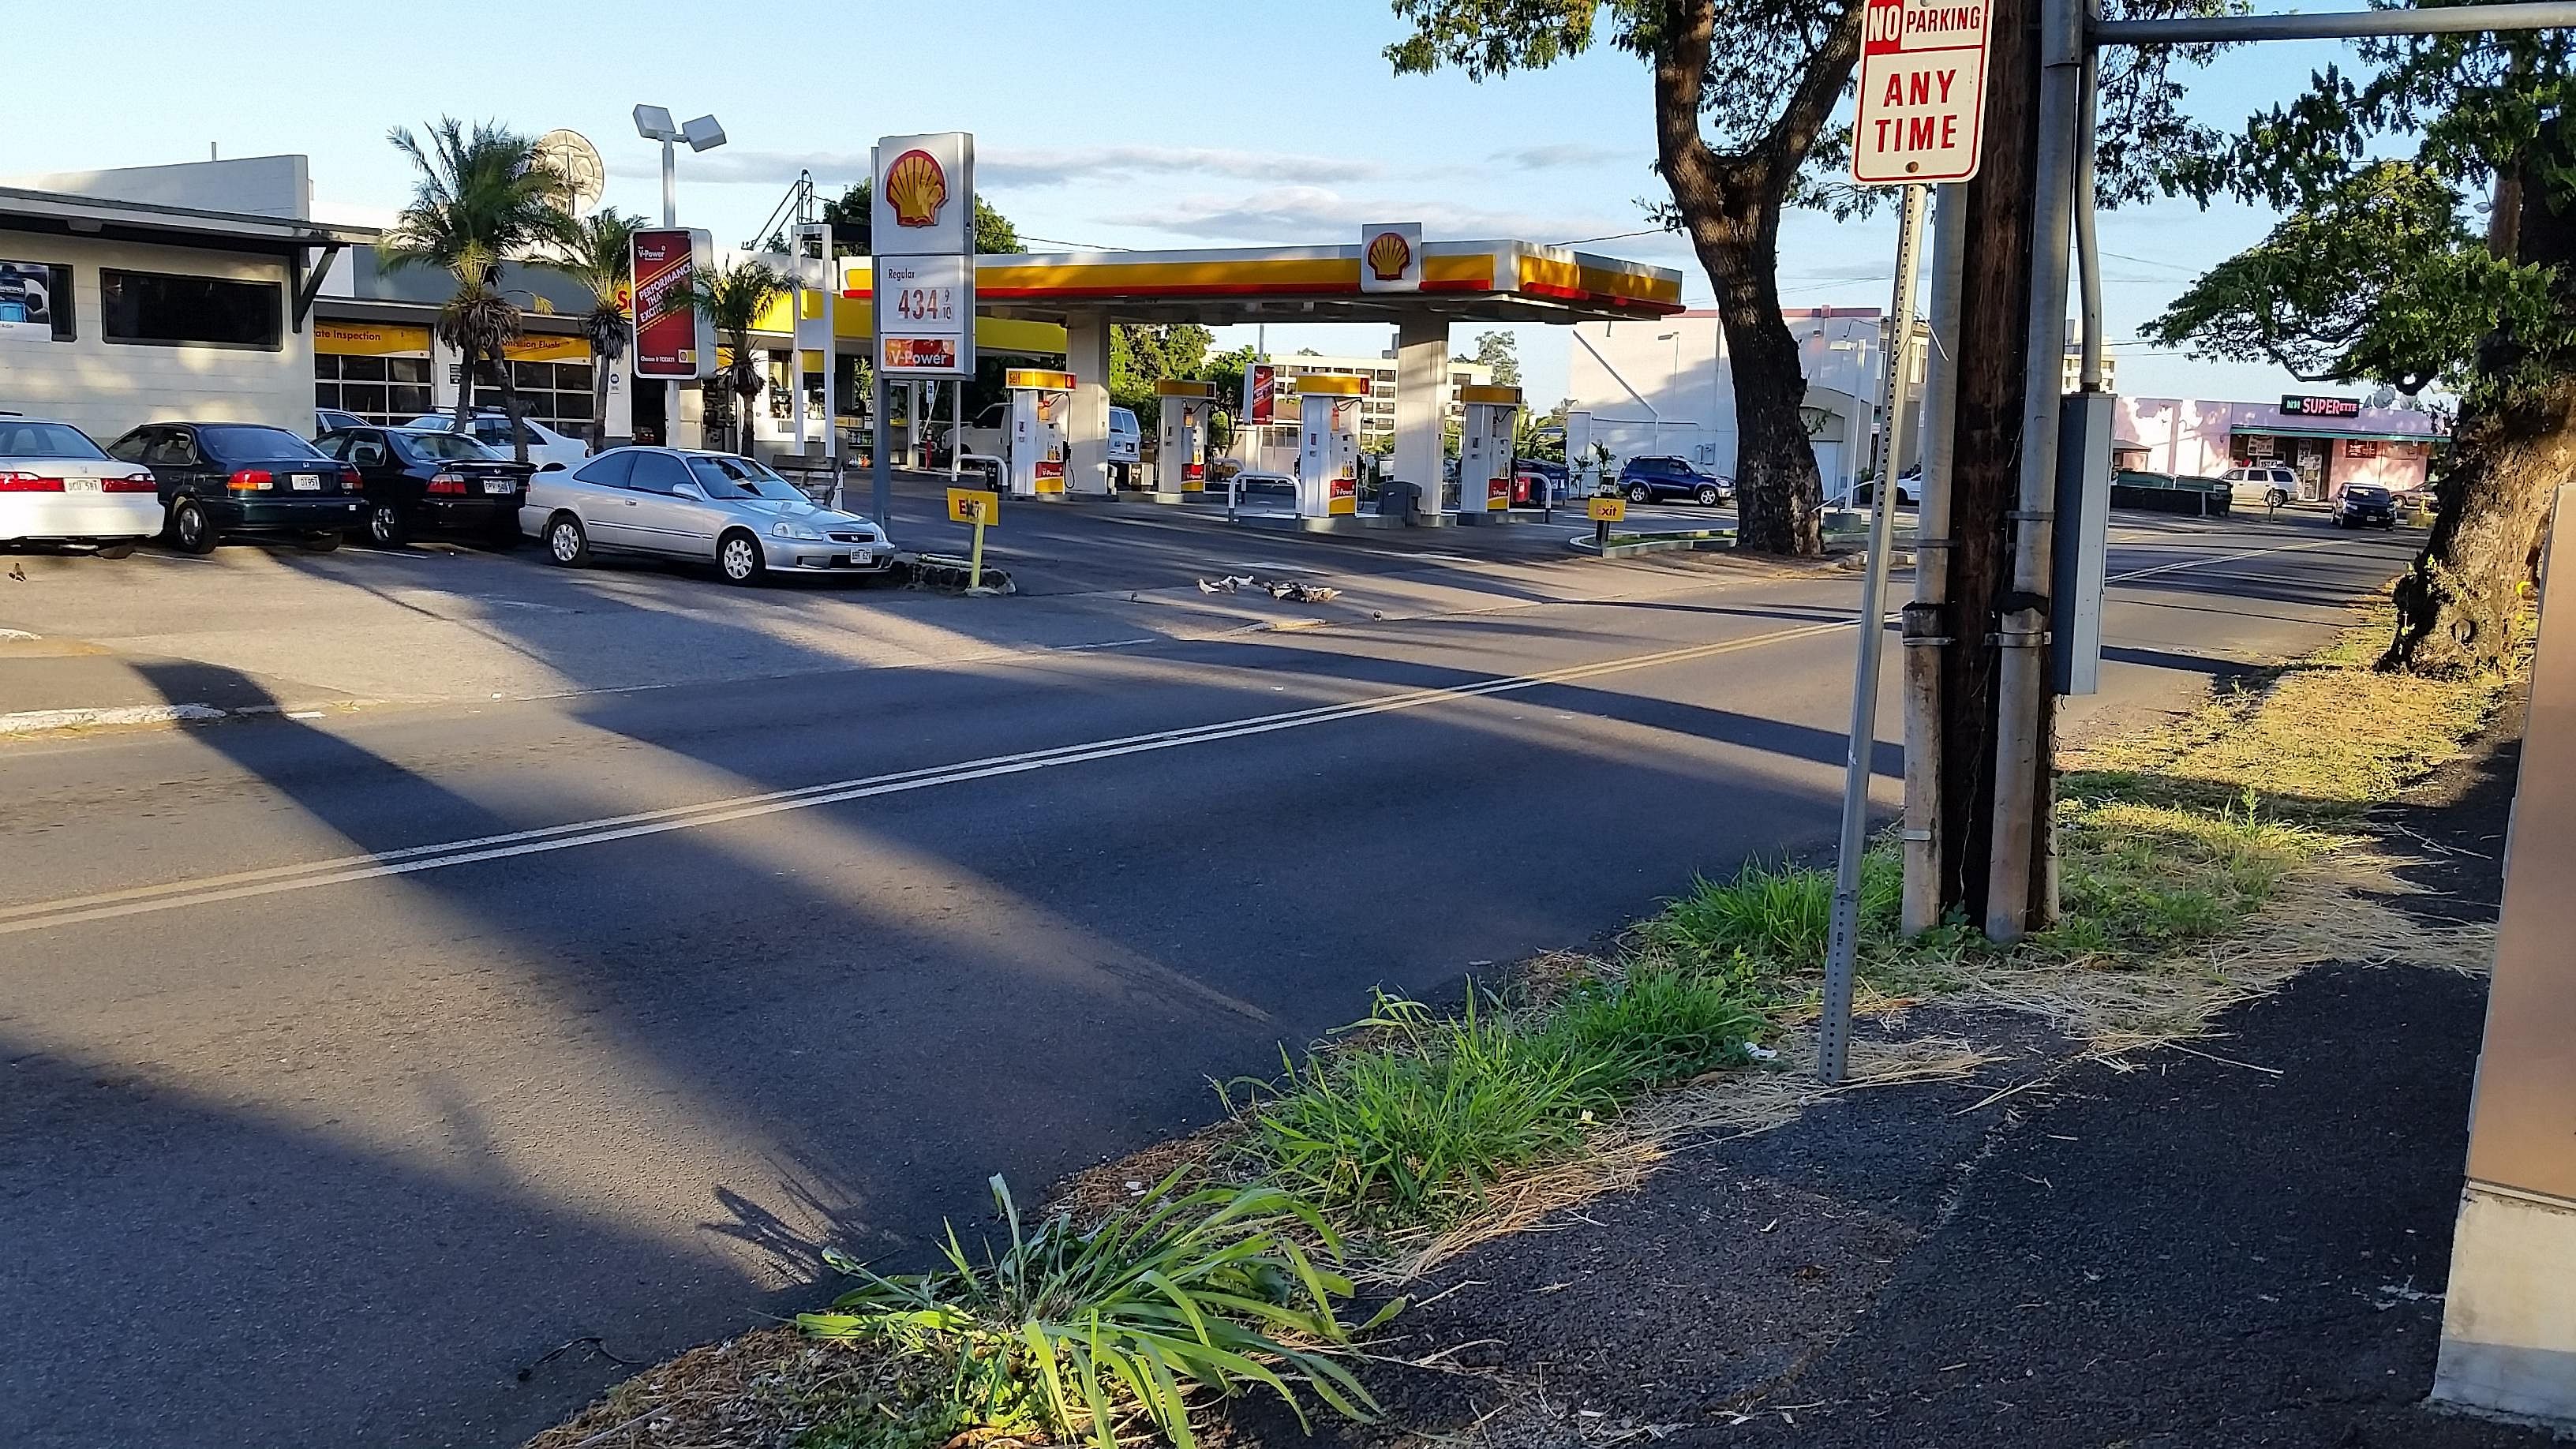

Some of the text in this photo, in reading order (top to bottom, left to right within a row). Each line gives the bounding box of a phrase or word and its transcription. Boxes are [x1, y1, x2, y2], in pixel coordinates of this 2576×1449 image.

[1867, 5, 1981, 42] NO PARKING
[1883, 69, 1956, 107] ANY
[1874, 114, 1957, 153] TIME
[638, 249, 665, 258] V-Power
[638, 262, 692, 301] PERFORMANCE
[888, 268, 915, 282] Regular
[639, 301, 666, 323] EXCITE
[898, 289, 938, 320] 434
[313, 329, 381, 342] ate Inspection
[890, 350, 947, 365] V-Power
[1009, 371, 1020, 384] Self
[1361, 380, 1366, 392] 6
[1597, 505, 1617, 516] Exit
